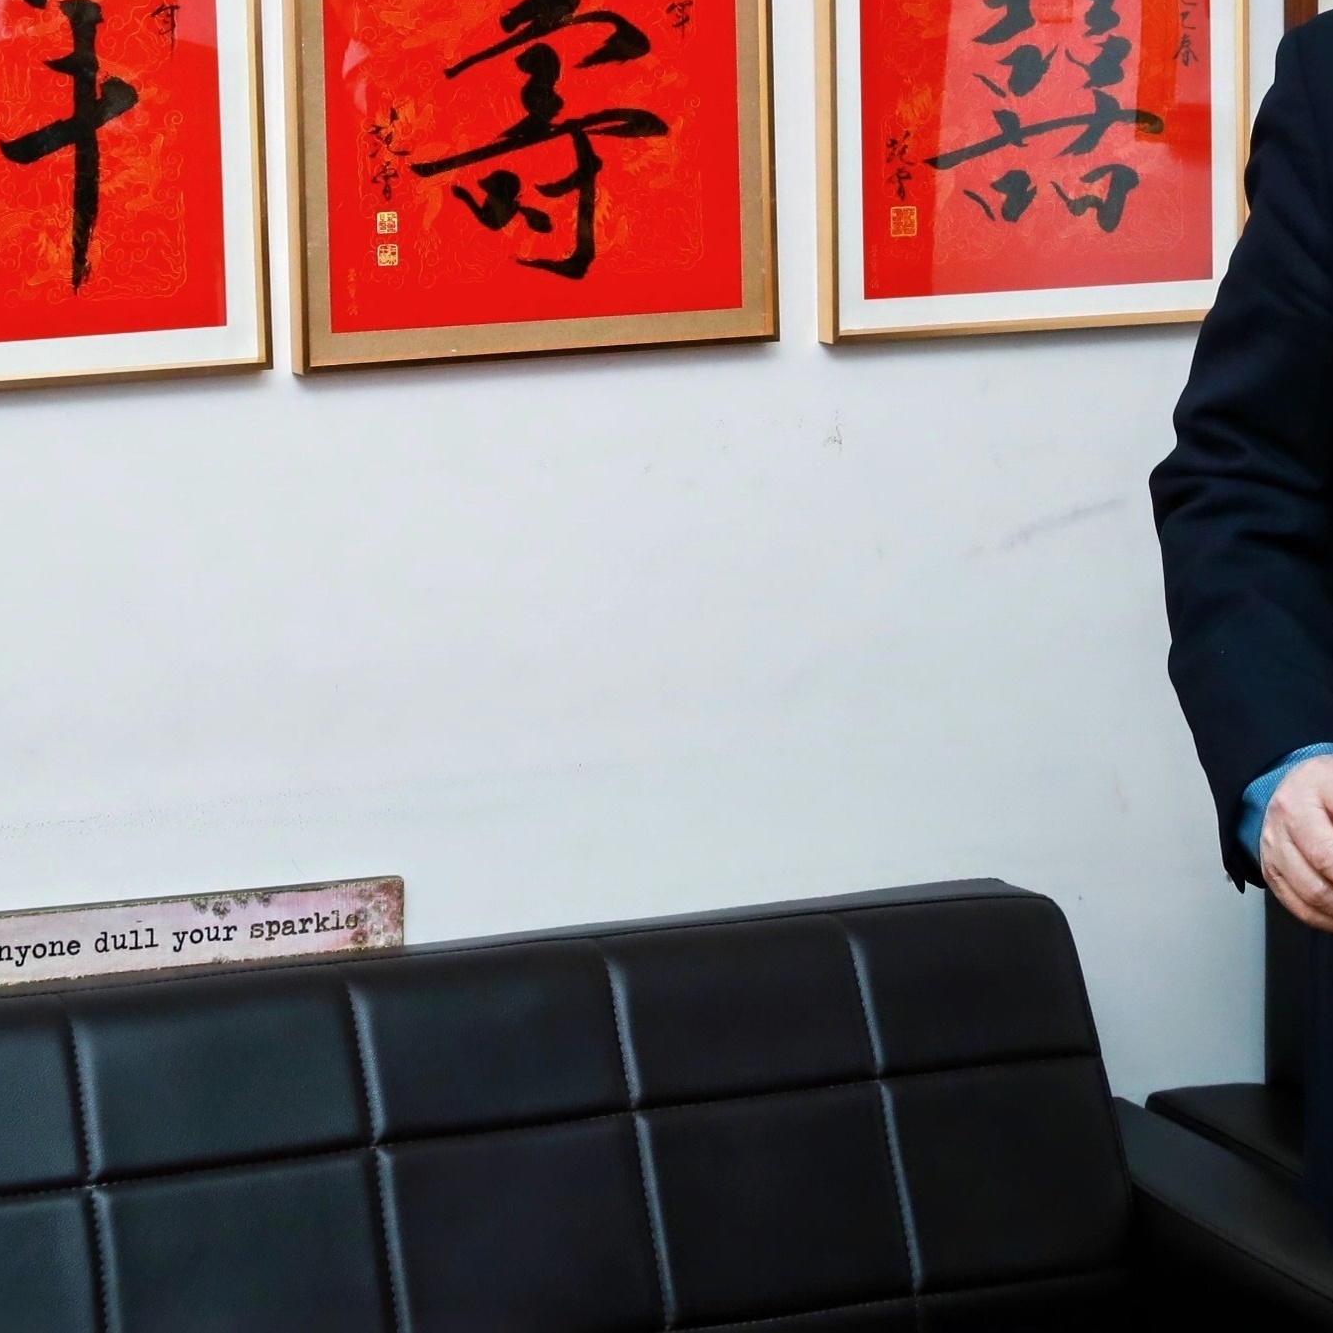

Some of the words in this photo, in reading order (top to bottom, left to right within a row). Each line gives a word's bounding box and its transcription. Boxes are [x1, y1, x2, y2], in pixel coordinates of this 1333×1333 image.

[95, 927, 159, 953] dull
[173, 923, 237, 952] your
[249, 909, 358, 941] sparkle
